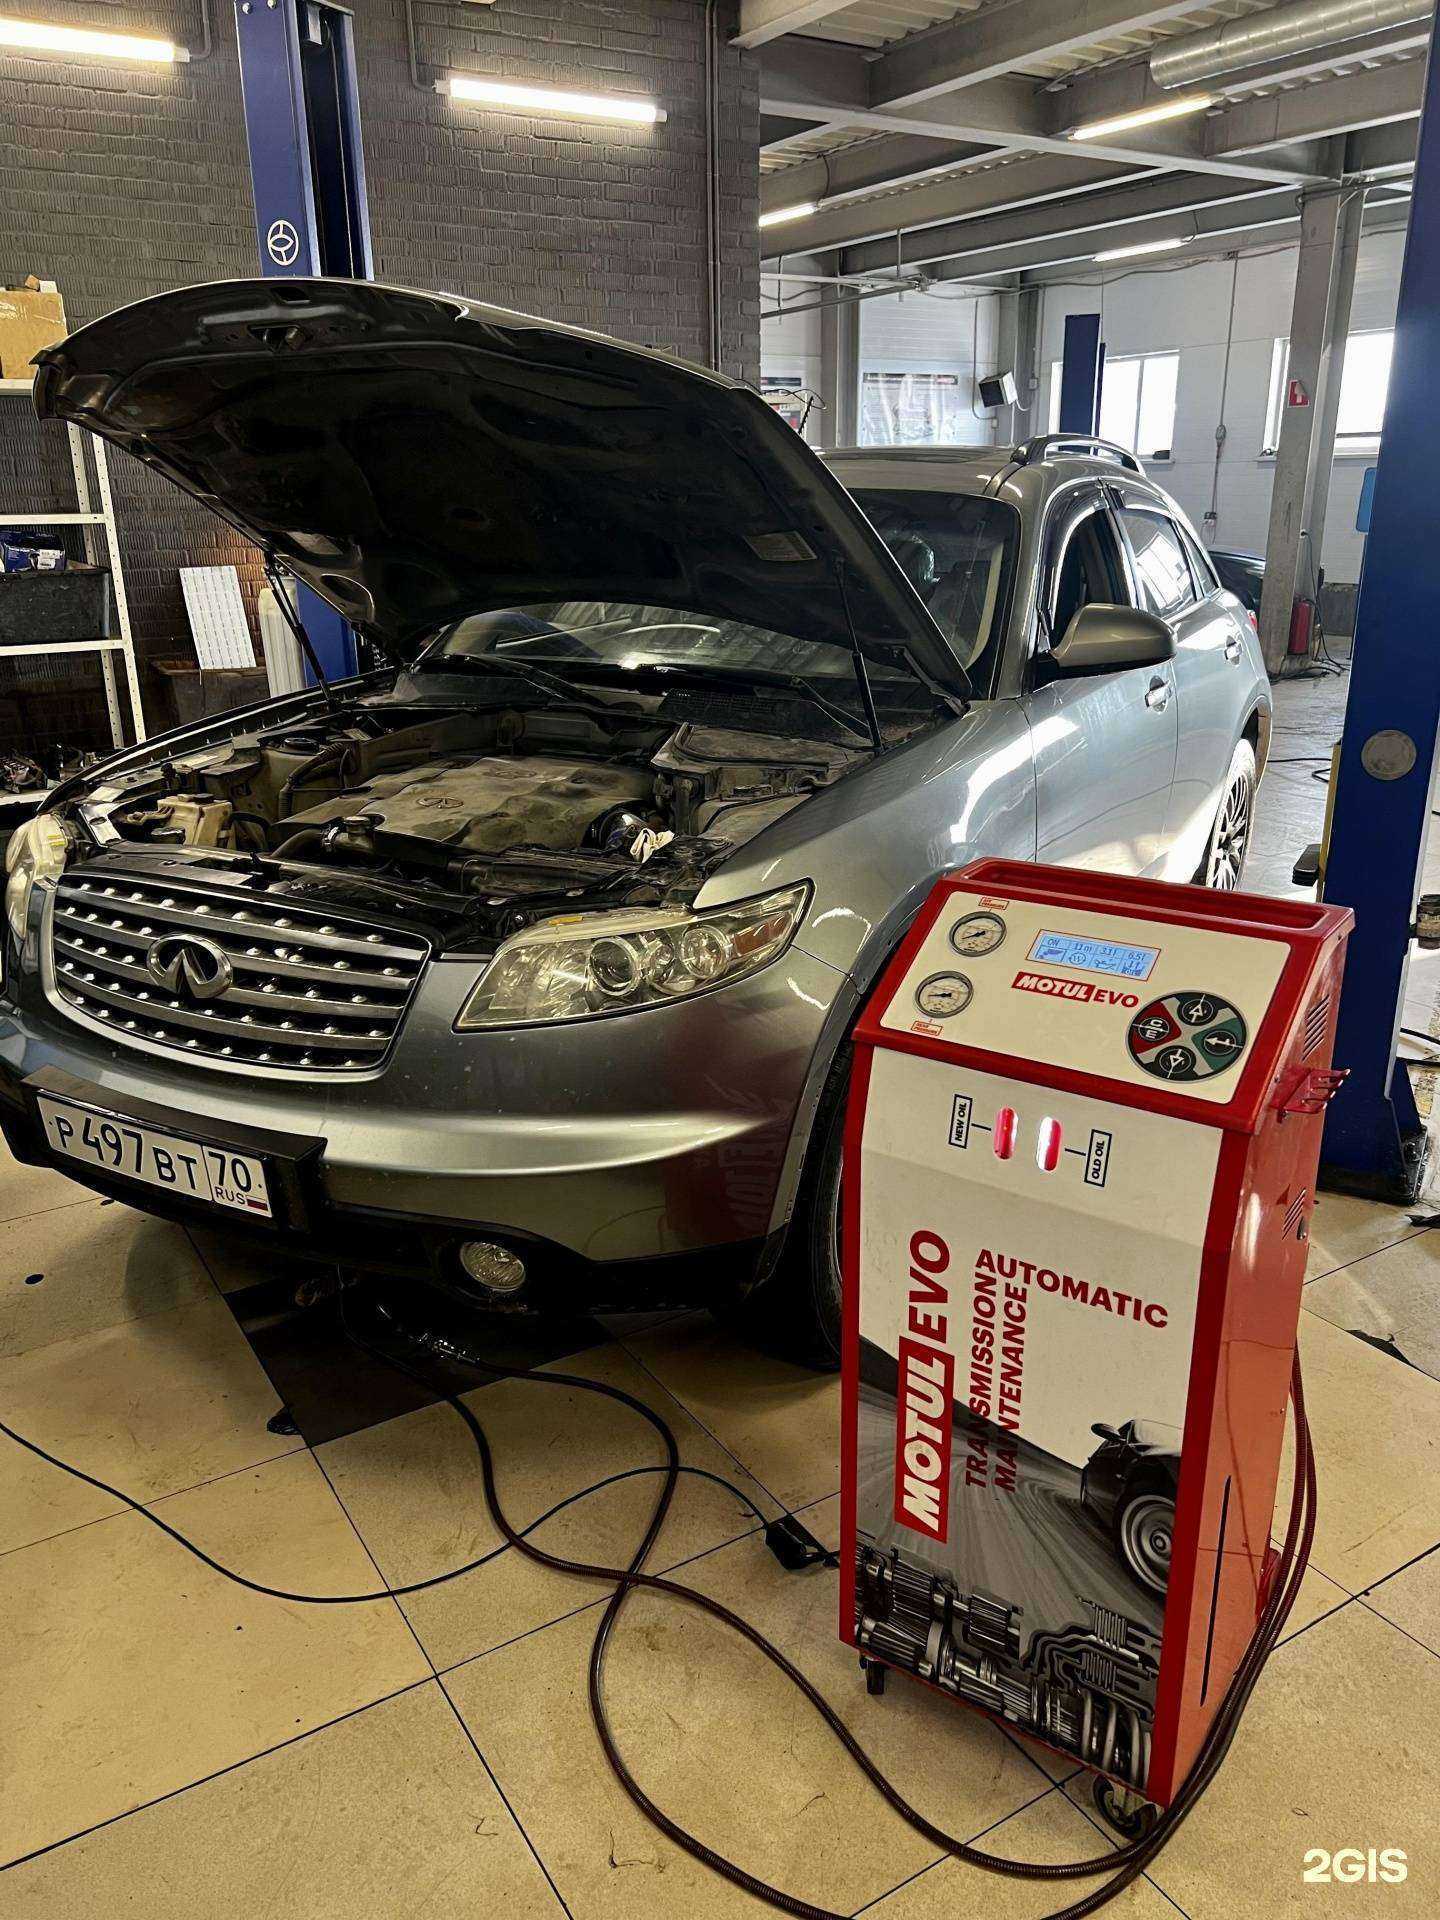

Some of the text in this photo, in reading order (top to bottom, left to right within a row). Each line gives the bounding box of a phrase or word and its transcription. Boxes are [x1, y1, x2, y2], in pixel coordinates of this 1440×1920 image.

[1016, 975, 1139, 1008] MOTUL EVO
[954, 1102, 967, 1142] NEW OIL
[207, 1150, 252, 1192] 70
[1091, 1140, 1105, 1180] OLD OIL
[214, 1186, 246, 1204] RUS
[975, 1248, 1168, 1329] AUTOMATIC
[902, 1230, 950, 1533] MOTUL EVO
[965, 1271, 997, 1489] TRANSMISSION
[993, 1282, 1027, 1494] MAINTENANCE
